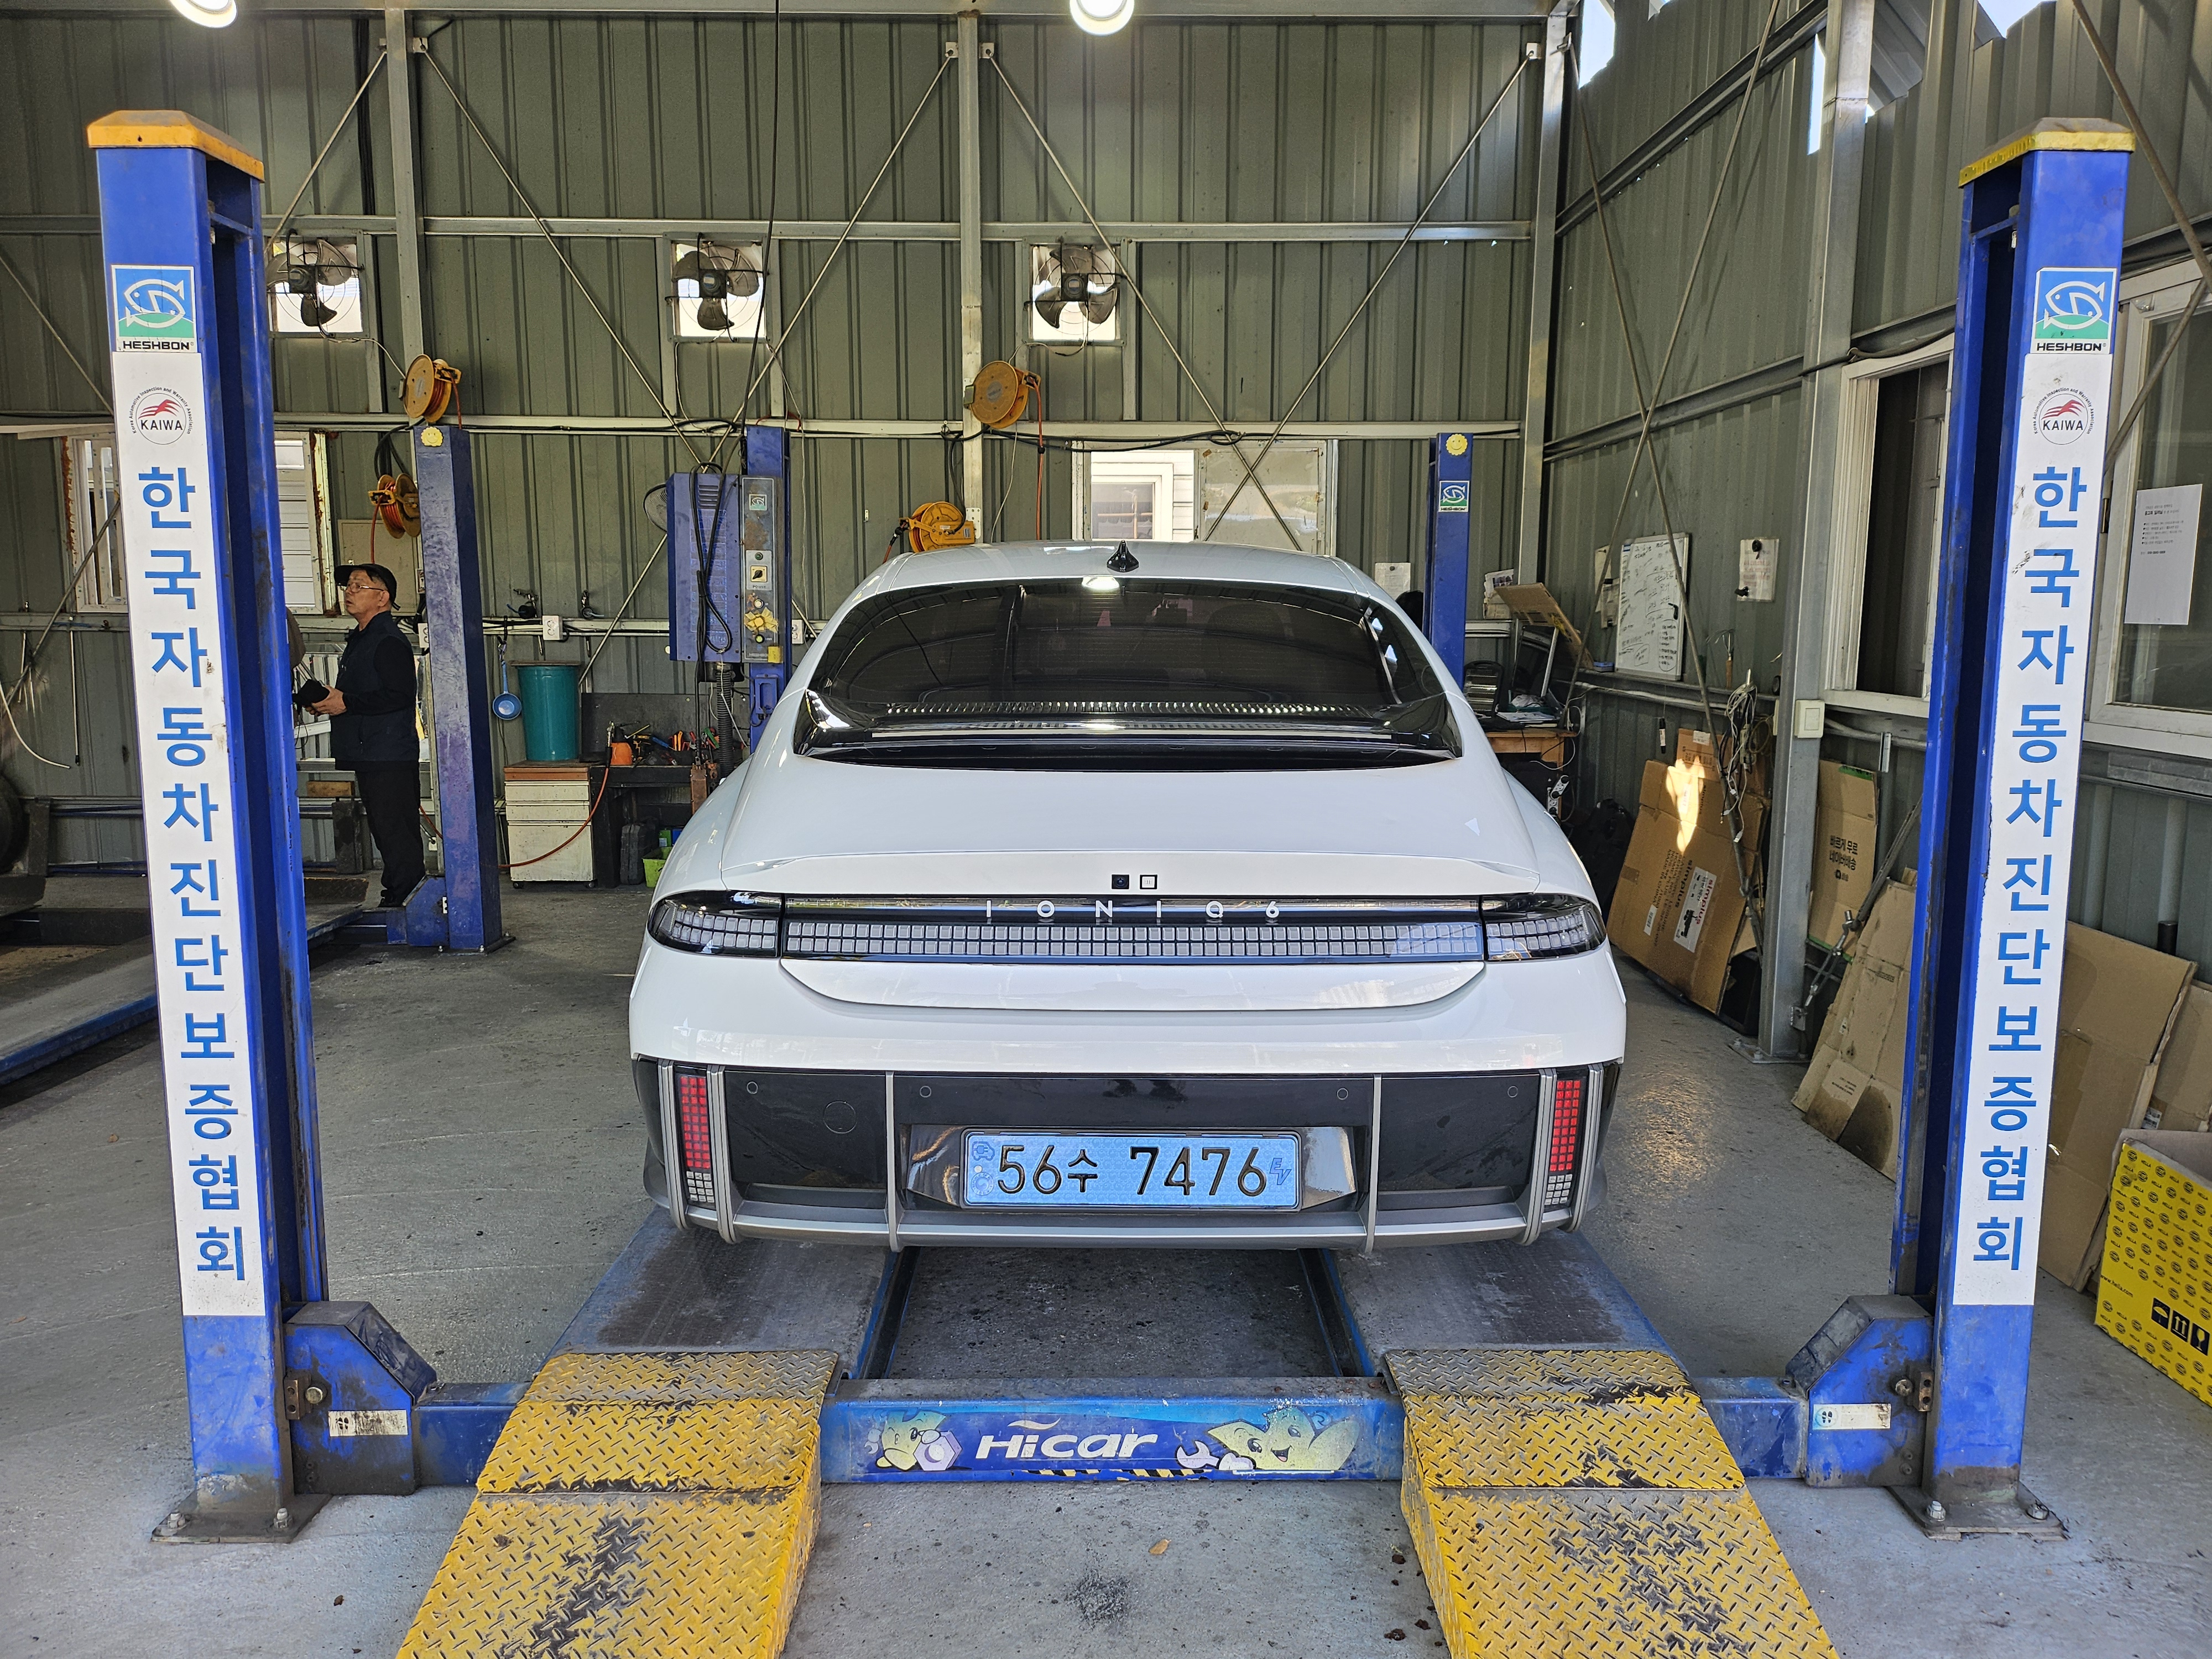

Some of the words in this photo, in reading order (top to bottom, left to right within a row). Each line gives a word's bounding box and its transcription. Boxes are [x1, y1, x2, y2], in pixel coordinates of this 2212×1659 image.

[173, 390, 188, 407] Warranty
[2078, 390, 2092, 407] Warranty
[140, 420, 183, 430] KAIWA
[2043, 420, 2083, 430] KAIWA
[1847, 841, 1858, 855] 무료
[1675, 860, 1693, 908] simplus
[1697, 879, 1713, 925] simplus
[997, 1145, 1098, 1194] 56수
[1130, 1146, 1267, 1197] 7476
[975, 1419, 1159, 1459] Hicar
